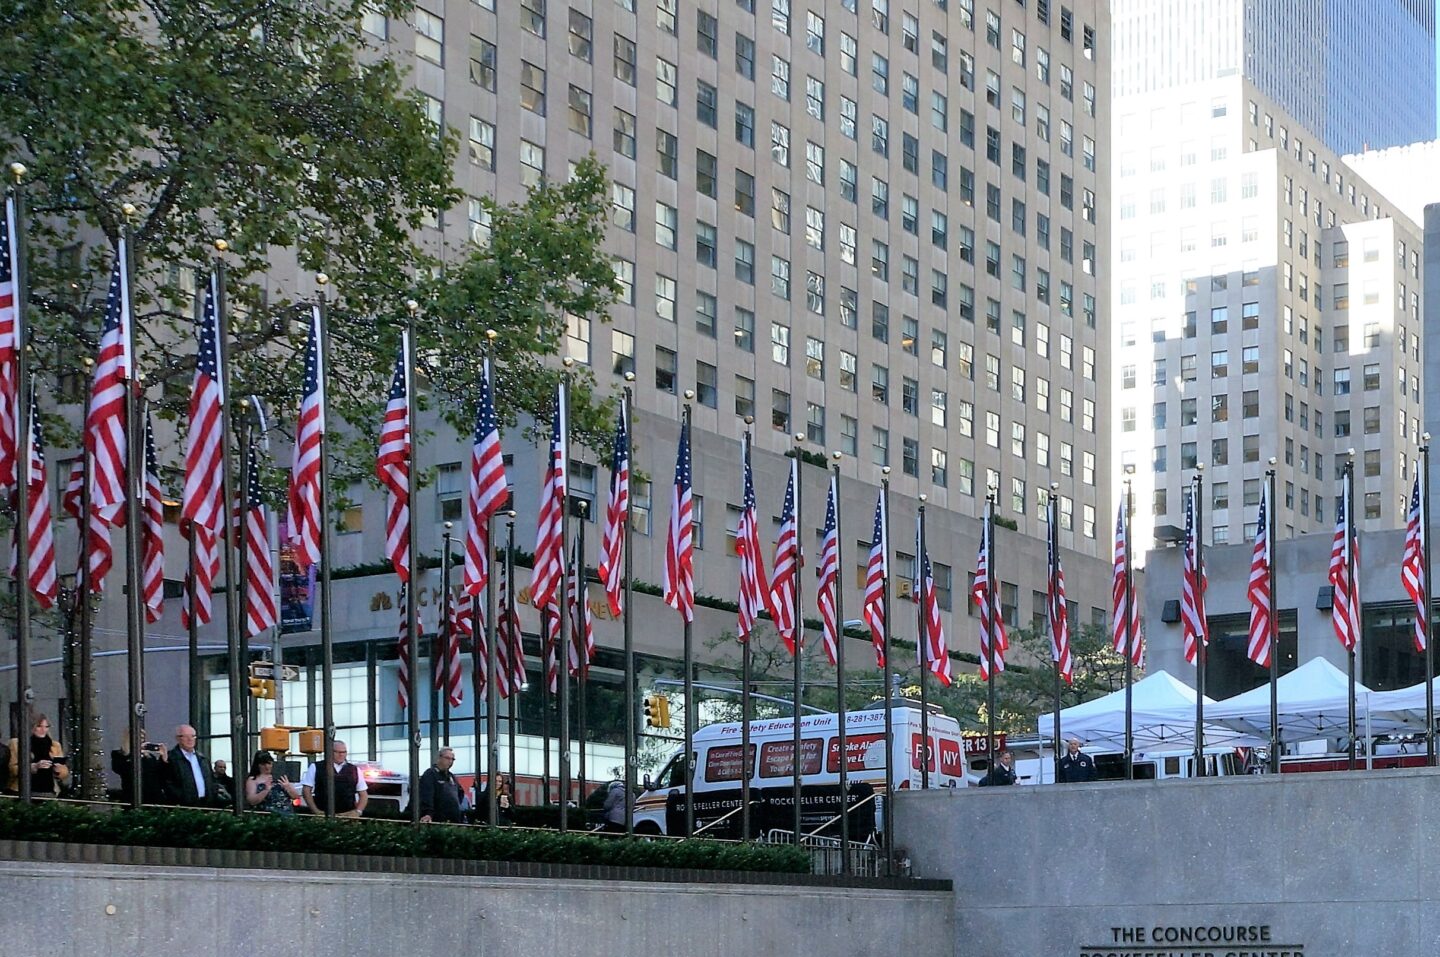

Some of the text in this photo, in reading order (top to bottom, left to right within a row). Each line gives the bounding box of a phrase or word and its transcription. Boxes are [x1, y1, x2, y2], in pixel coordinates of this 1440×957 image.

[721, 727, 738, 735] Fire
[768, 721, 811, 731] Educaon
[813, 717, 832, 726] Unit
[974, 737, 987, 752] 13
[943, 750, 959, 766] NY
[676, 799, 744, 812] ROEFELLER CENTE
[770, 794, 857, 805] ROCKEELLER CENER
[1111, 925, 1271, 942] THE CONCOURSE
